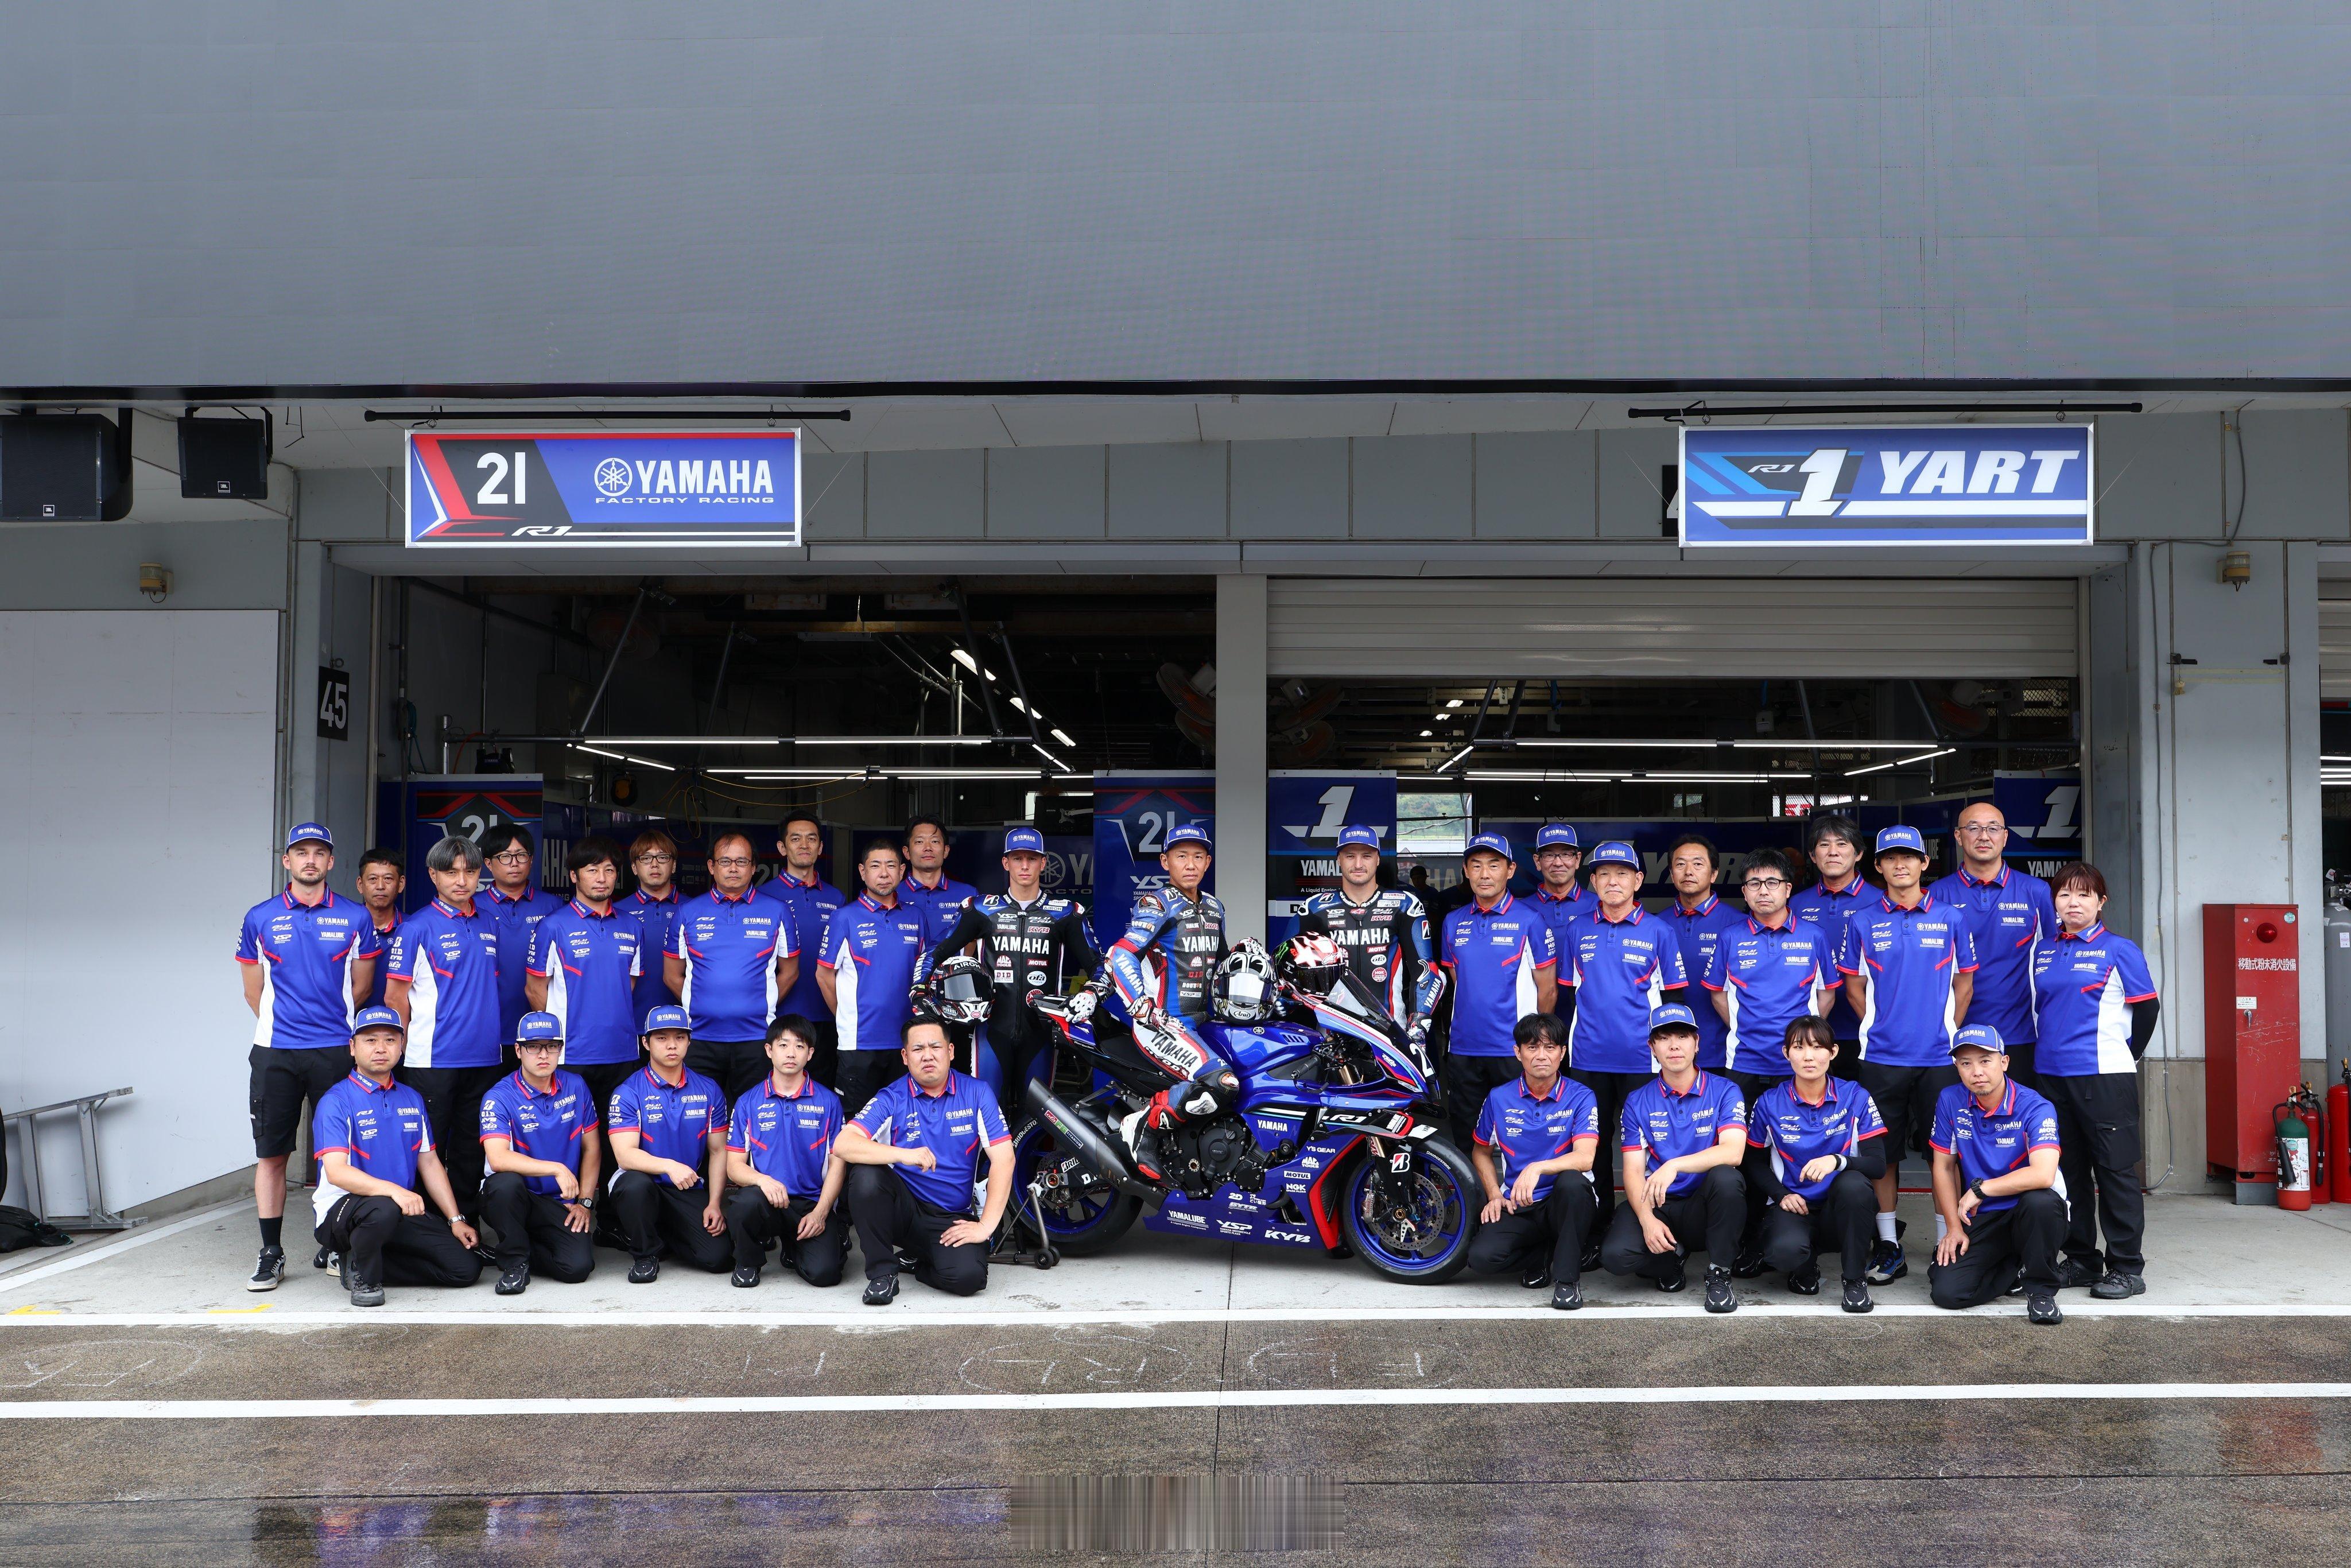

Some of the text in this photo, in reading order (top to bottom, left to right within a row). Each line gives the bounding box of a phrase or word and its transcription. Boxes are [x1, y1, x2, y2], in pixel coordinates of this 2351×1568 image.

[476, 452, 526, 504] 21
[635, 460, 773, 494] YAMAHA
[1879, 451, 2080, 494] YART
[1787, 449, 1848, 516] 1
[320, 681, 347, 729] 45
[1301, 860, 1342, 876] YAMAL
[1182, 936, 1219, 953] YAMAH
[1329, 928, 1390, 945] YAMAHA
[1630, 940, 1653, 949] YAMAHA
[992, 937, 1049, 954] YAMAHA
[2082, 949, 2105, 957] YAMAHA
[1624, 953, 1647, 962] YAMALUBE
[2239, 958, 2296, 971] 移動式粉末消火設備
[954, 961, 980, 971] AIROH
[1115, 953, 1145, 995] YAMAHA
[1424, 977, 1441, 1008] YAMAHA
[1235, 1011, 1250, 1019] Arai
[1150, 1032, 1198, 1068] YAMAHA
[952, 1109, 973, 1118] YAMAHA
[951, 1124, 973, 1134] YAMALUBE
[1012, 1119, 1038, 1148] BRIDGESTO
[1258, 1120, 1287, 1132] YAMAHA
[1066, 1132, 1081, 1147] TITANIUM
[1426, 1151, 1451, 1170] BRIDGESTONE
[1169, 1210, 1206, 1224] YAMALUBE
[1216, 1220, 1252, 1231] YSP
[1264, 1230, 1310, 1243] KYB
